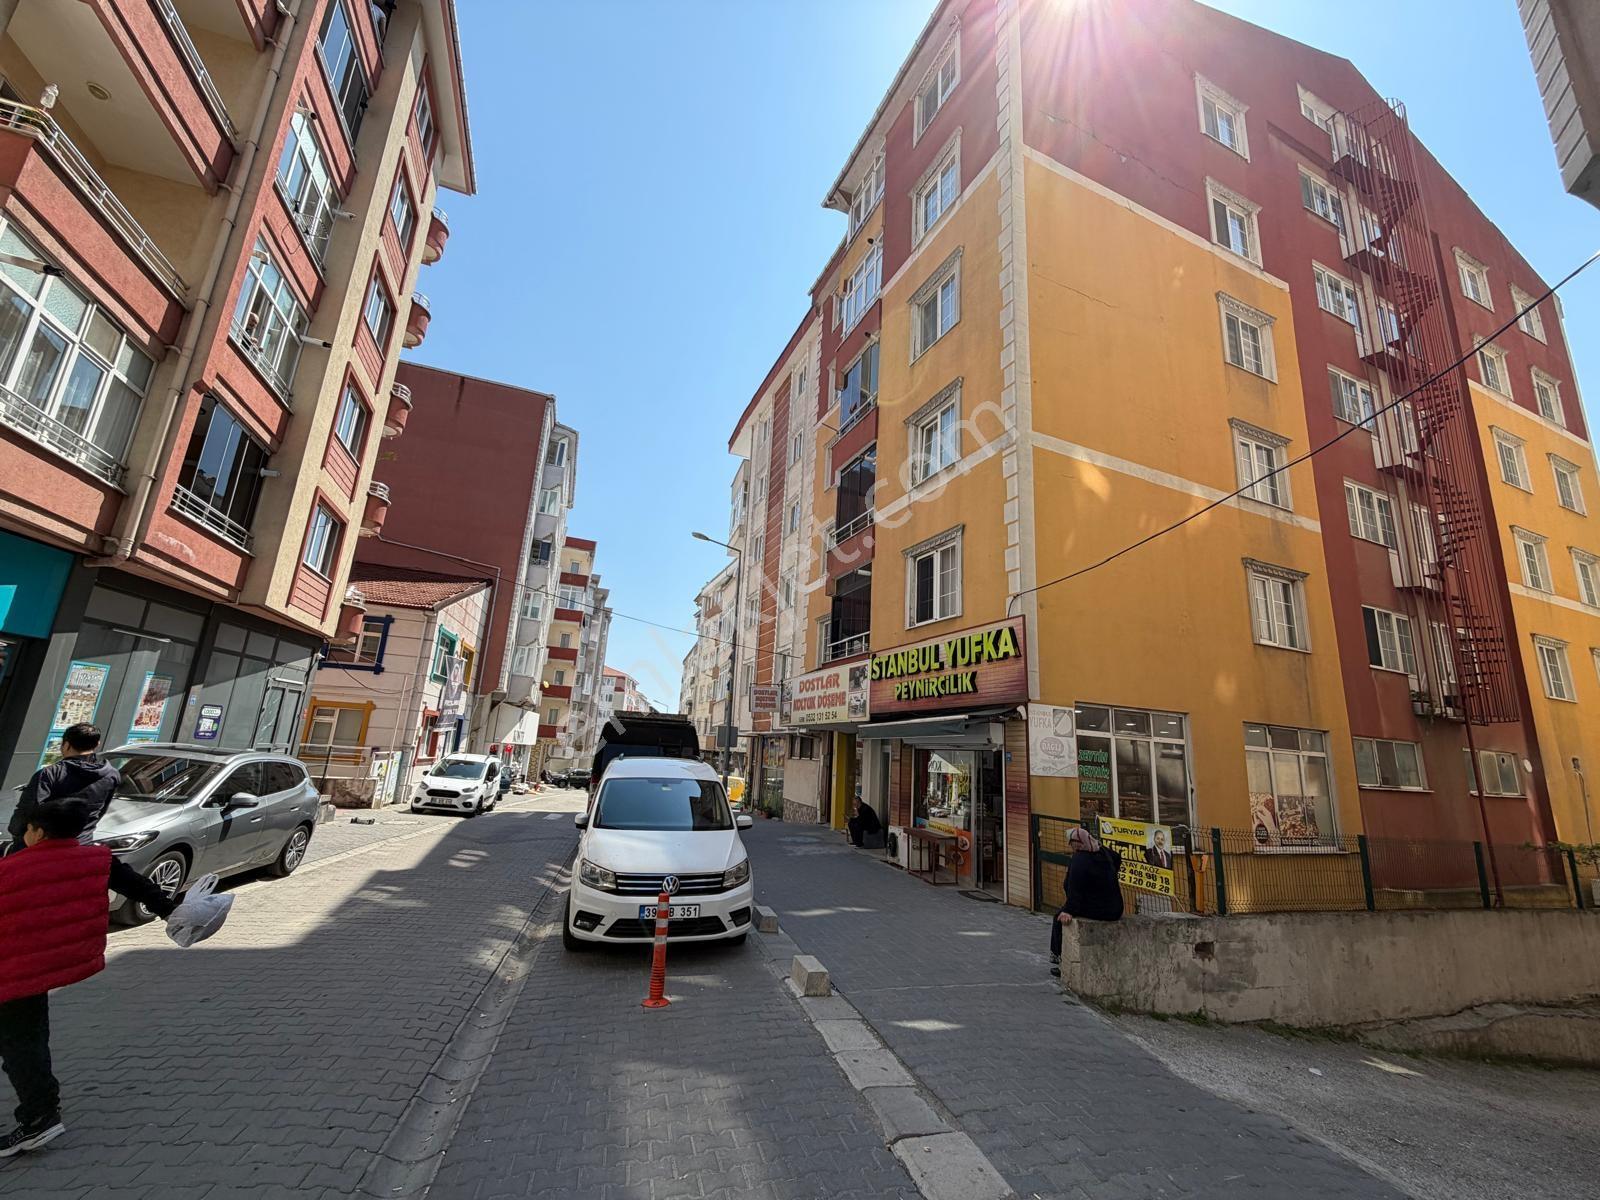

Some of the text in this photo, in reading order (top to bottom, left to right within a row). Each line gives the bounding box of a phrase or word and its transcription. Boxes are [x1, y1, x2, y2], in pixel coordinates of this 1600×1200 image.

[944, 627, 1016, 667] YUFKA
[799, 672, 840, 693] DOSTLAR
[831, 710, 838, 720] 54
[1112, 826, 1145, 836] TURYAP
[1129, 876, 1143, 886] 120
[1159, 884, 1170, 893] 28
[1160, 876, 1170, 886] 18
[645, 907, 657, 918] 39
[680, 907, 697, 917] 351
